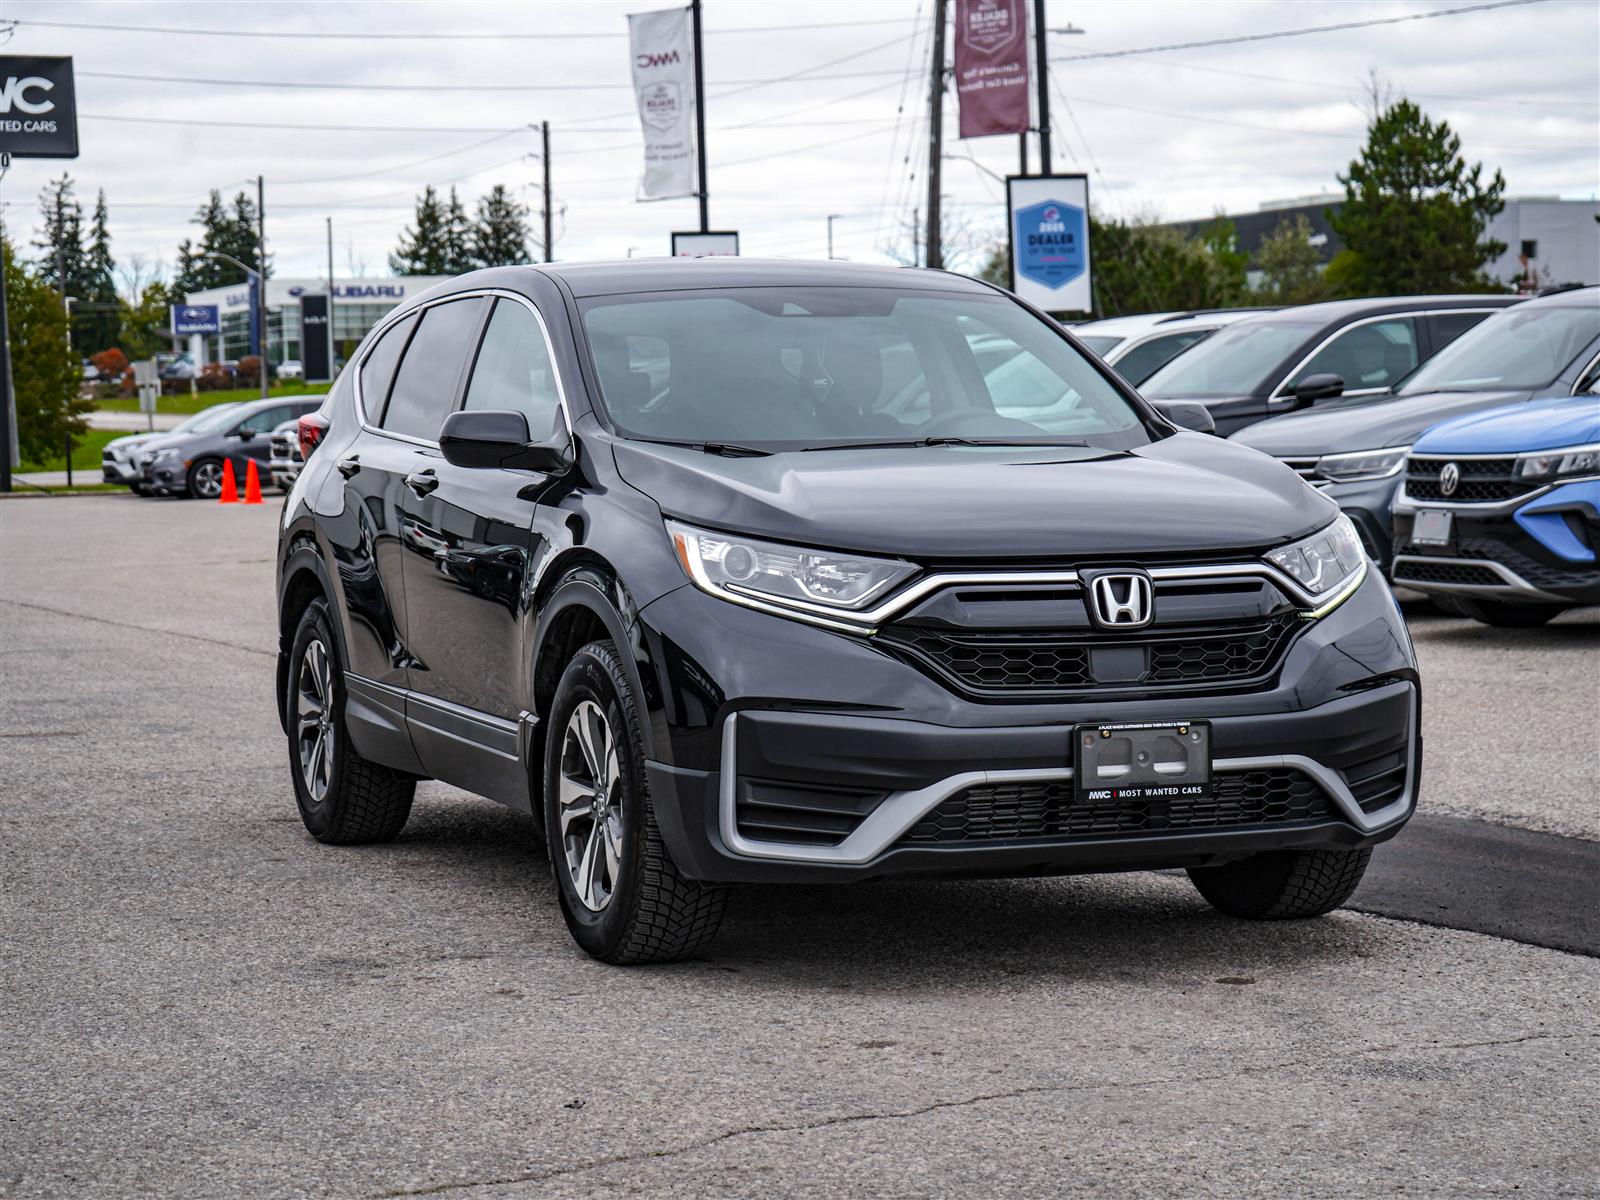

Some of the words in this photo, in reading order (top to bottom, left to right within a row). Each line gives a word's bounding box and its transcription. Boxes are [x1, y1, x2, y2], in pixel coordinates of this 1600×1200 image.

[23, 120, 58, 132] CARS
[1028, 233, 1074, 246] DEALER
[177, 322, 218, 332] SUBARU
[1119, 789, 1141, 797] MOST
[1145, 787, 1179, 796] WANTED
[1182, 786, 1202, 794] CARS
